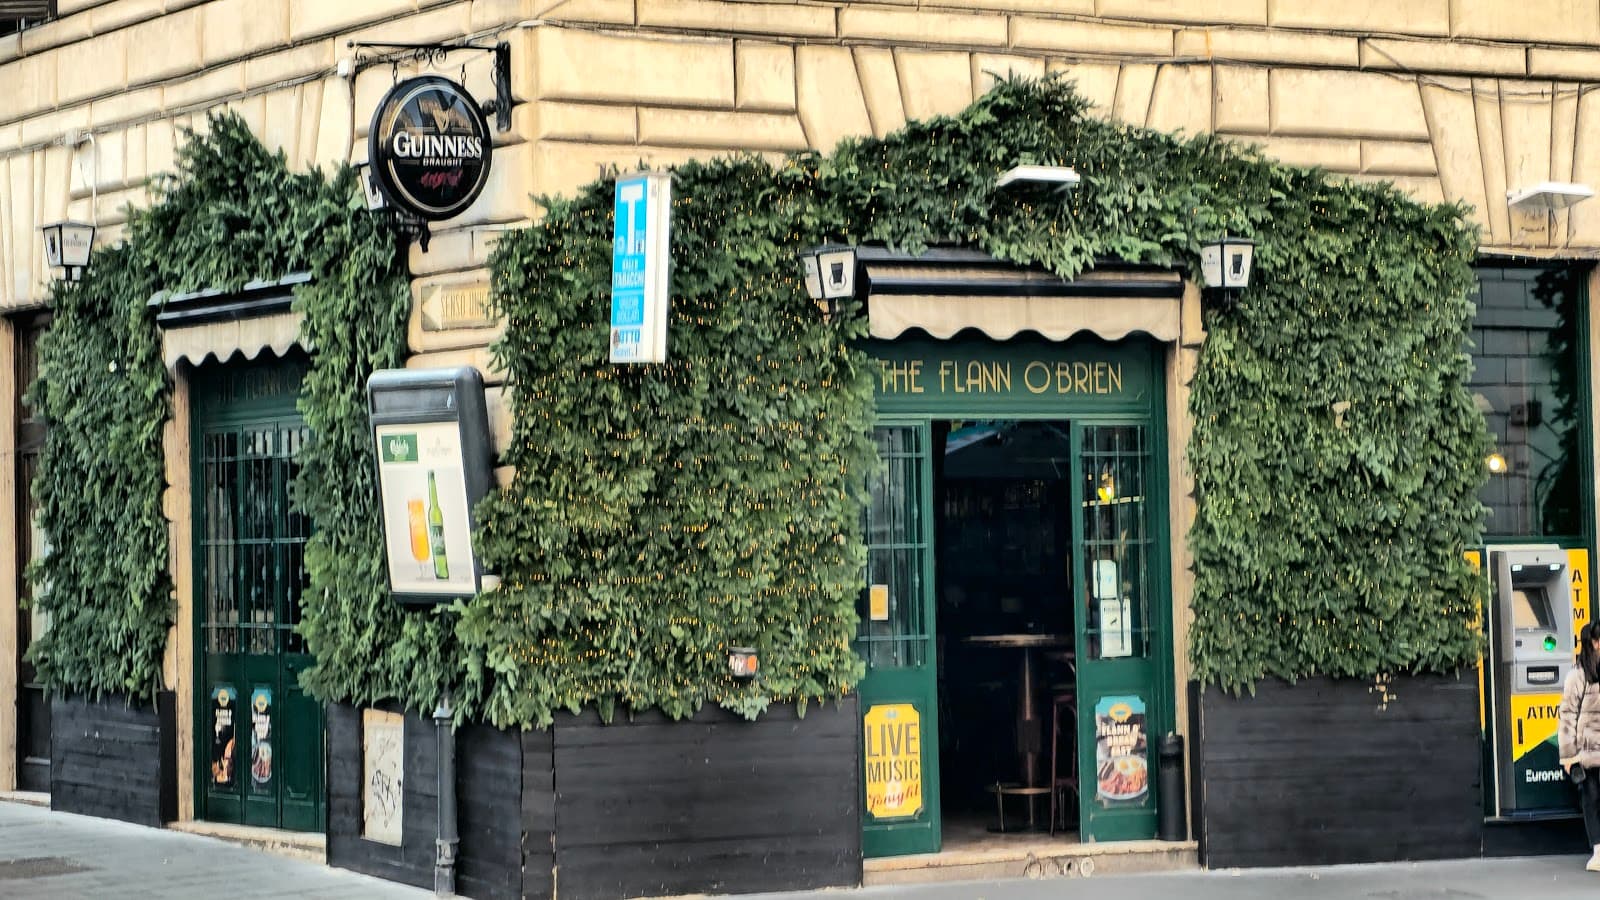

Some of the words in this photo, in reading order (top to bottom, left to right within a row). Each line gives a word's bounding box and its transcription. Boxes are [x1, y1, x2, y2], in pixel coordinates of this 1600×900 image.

[393, 130, 482, 158] GUINNESS
[422, 158, 462, 167] DRAUGHT
[621, 184, 643, 255] T
[880, 360, 924, 393] THE
[939, 360, 1011, 393] FLANN
[1024, 360, 1122, 394] O'BRIEN
[1527, 705, 1560, 720] ATM
[867, 723, 918, 757] LIVE
[867, 759, 918, 783] MUSIC
